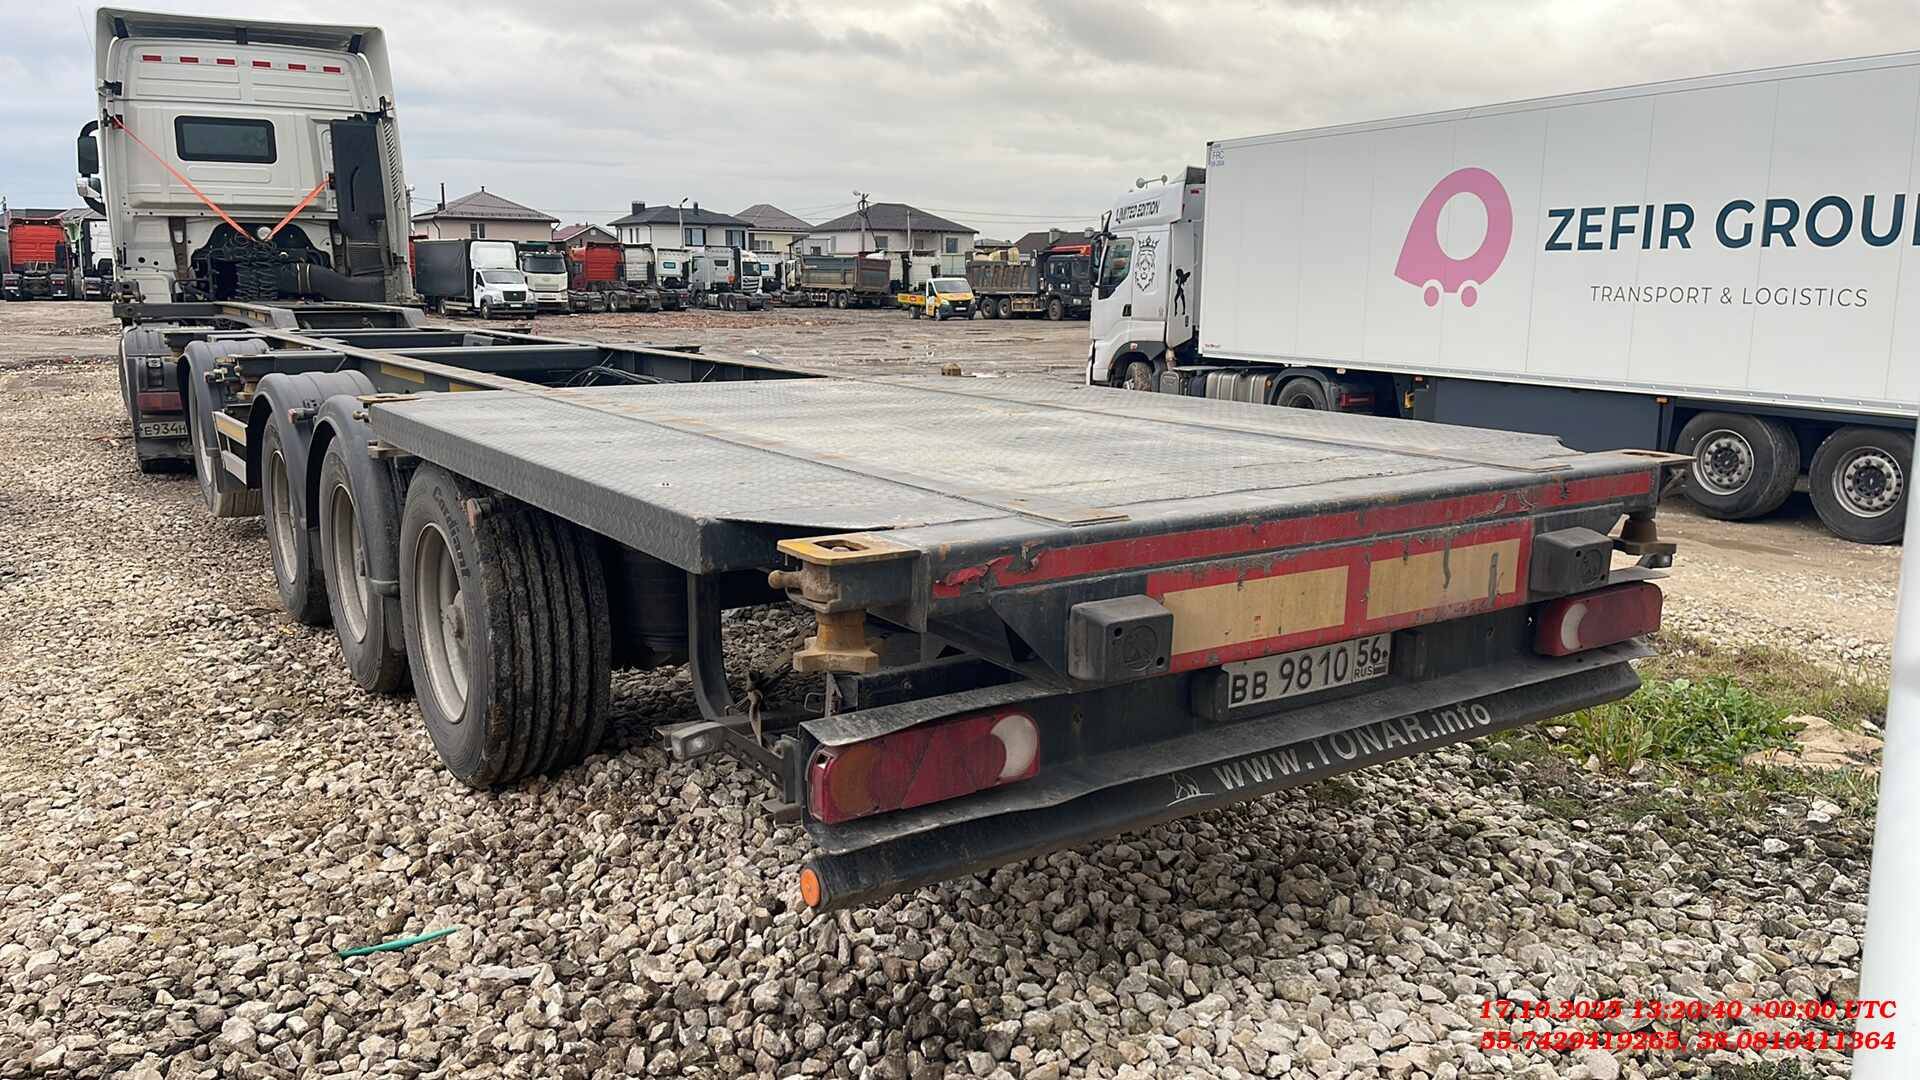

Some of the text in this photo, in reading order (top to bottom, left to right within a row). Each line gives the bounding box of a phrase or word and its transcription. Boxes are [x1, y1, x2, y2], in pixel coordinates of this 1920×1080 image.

[1544, 203, 1696, 252] ZEFIR
[1590, 285, 1869, 308] TRANSPORT & LOGISTICS
[1231, 636, 1381, 704] BB 9810 56
[1354, 666, 1374, 679] RUS
